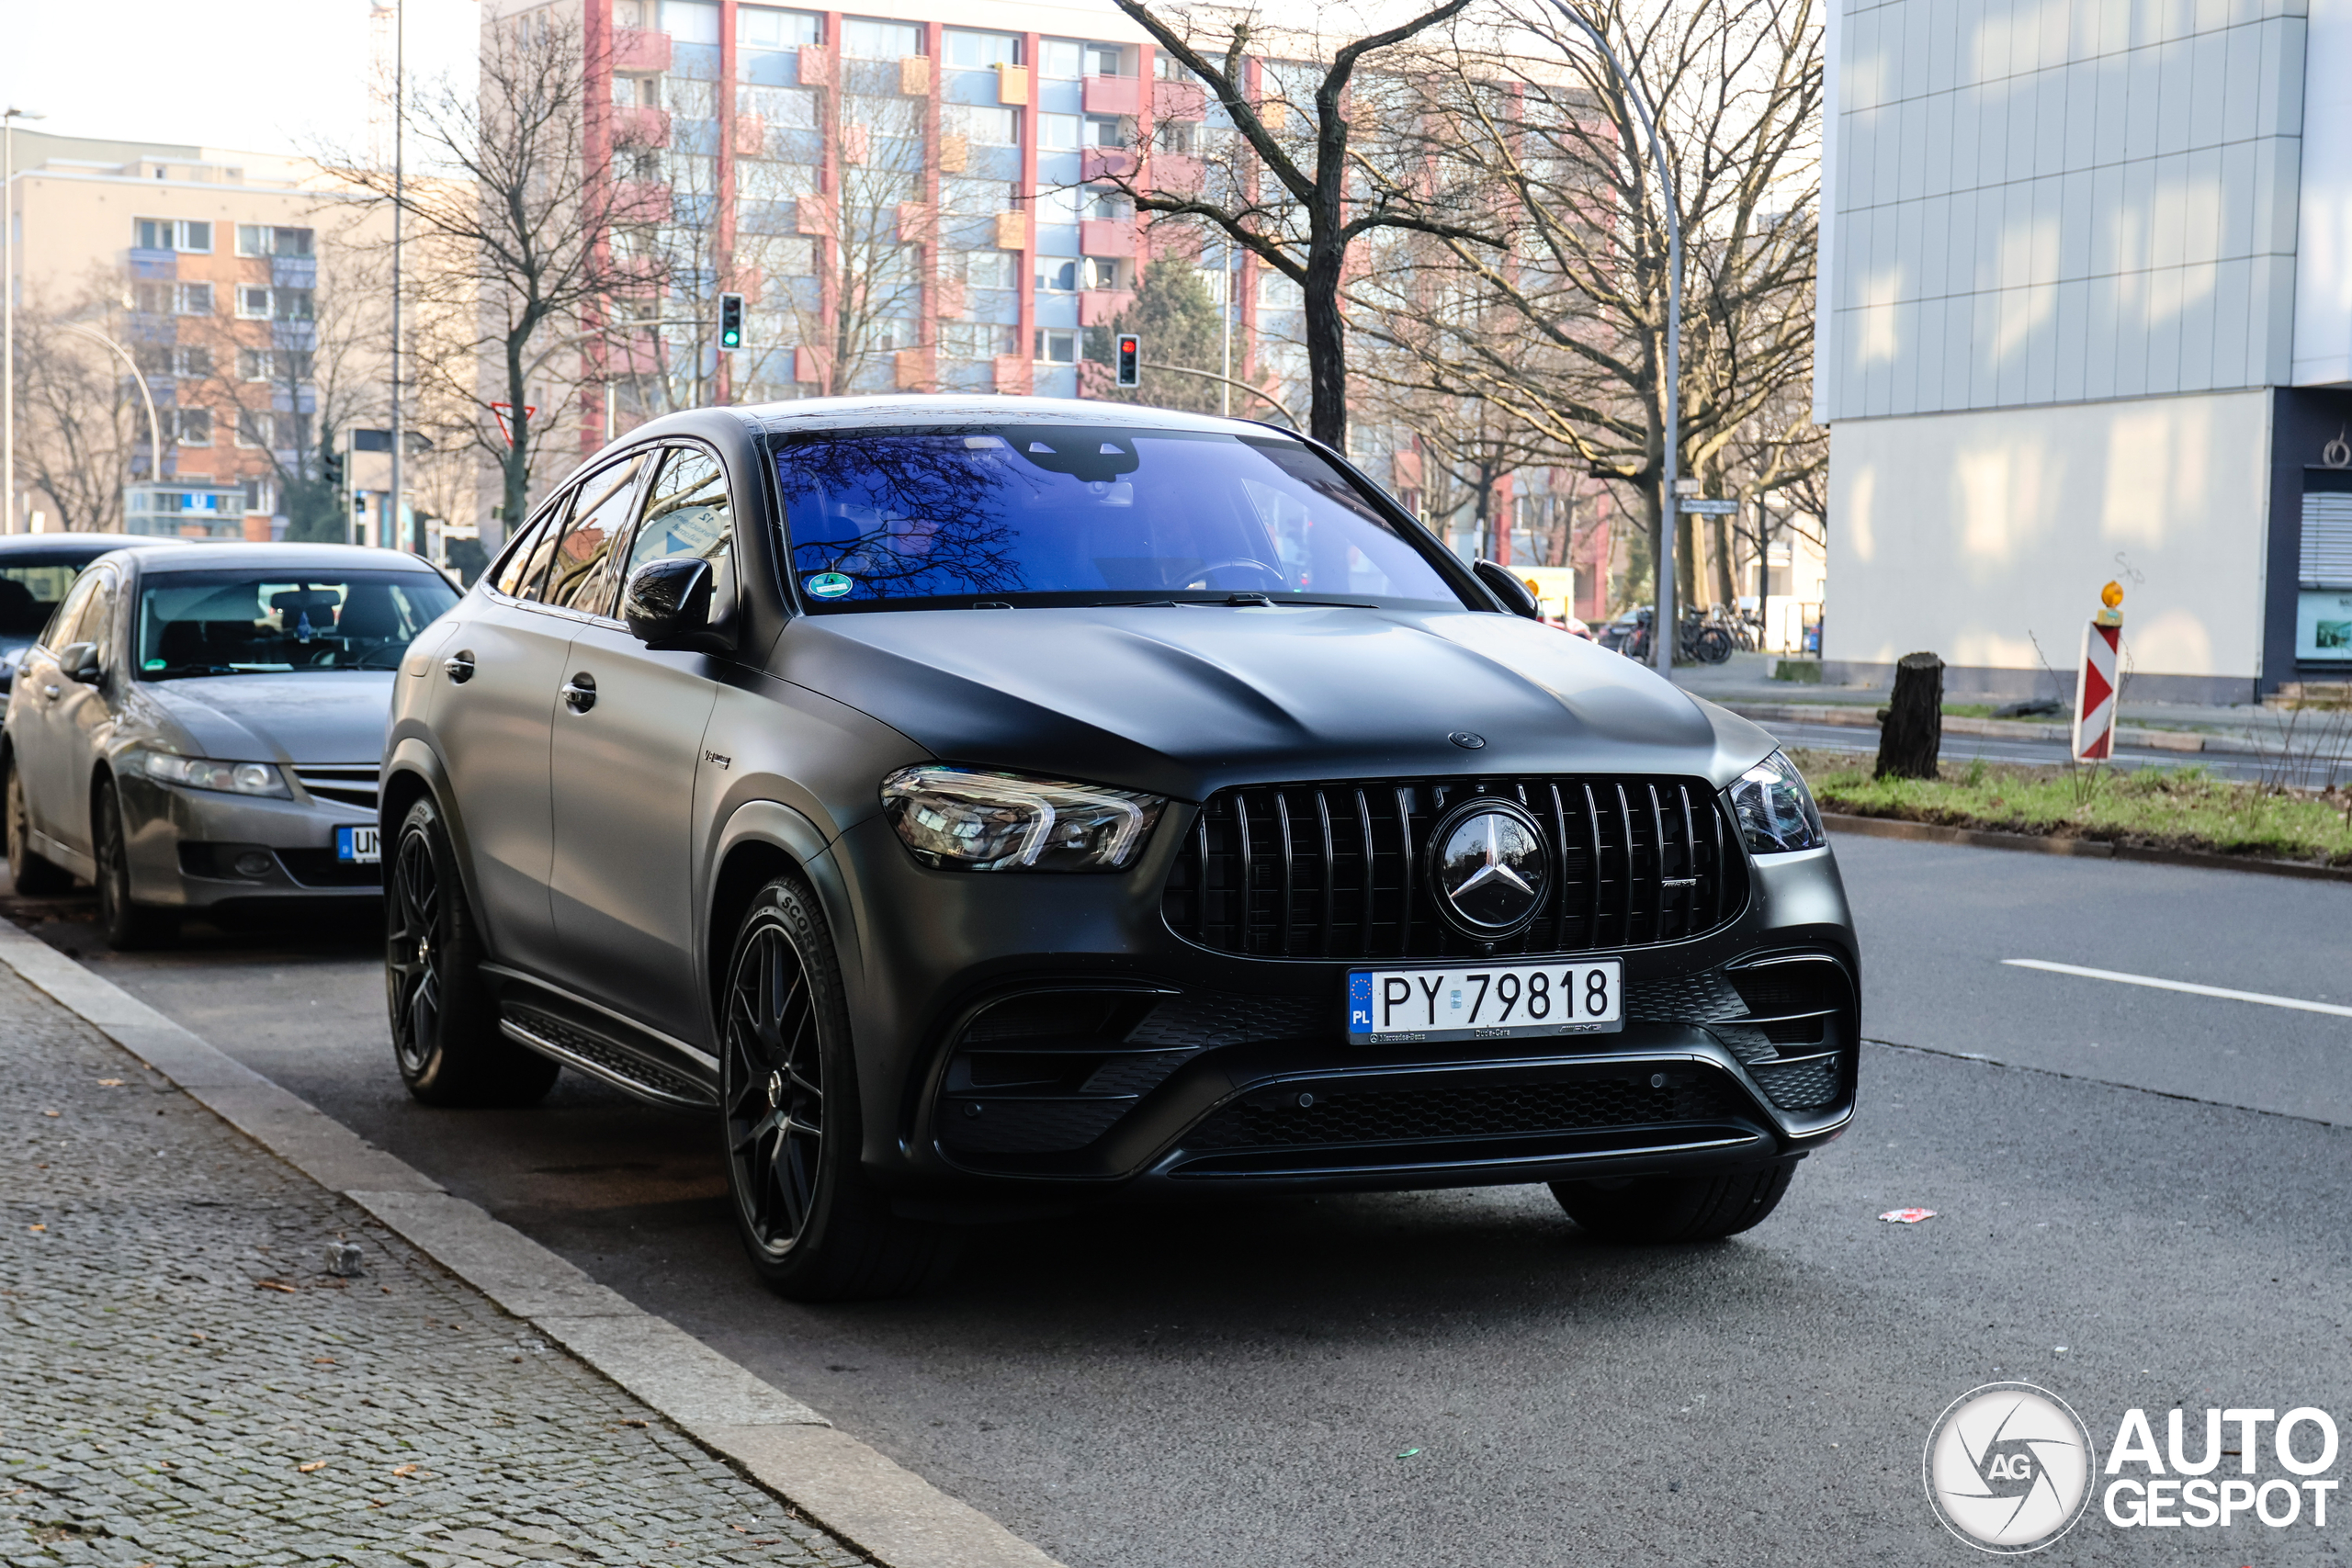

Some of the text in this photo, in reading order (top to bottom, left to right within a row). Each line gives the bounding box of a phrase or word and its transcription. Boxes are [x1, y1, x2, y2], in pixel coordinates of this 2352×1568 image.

[1384, 968, 1608, 1027] PY 79818
[1352, 1010, 1370, 1024] PL
